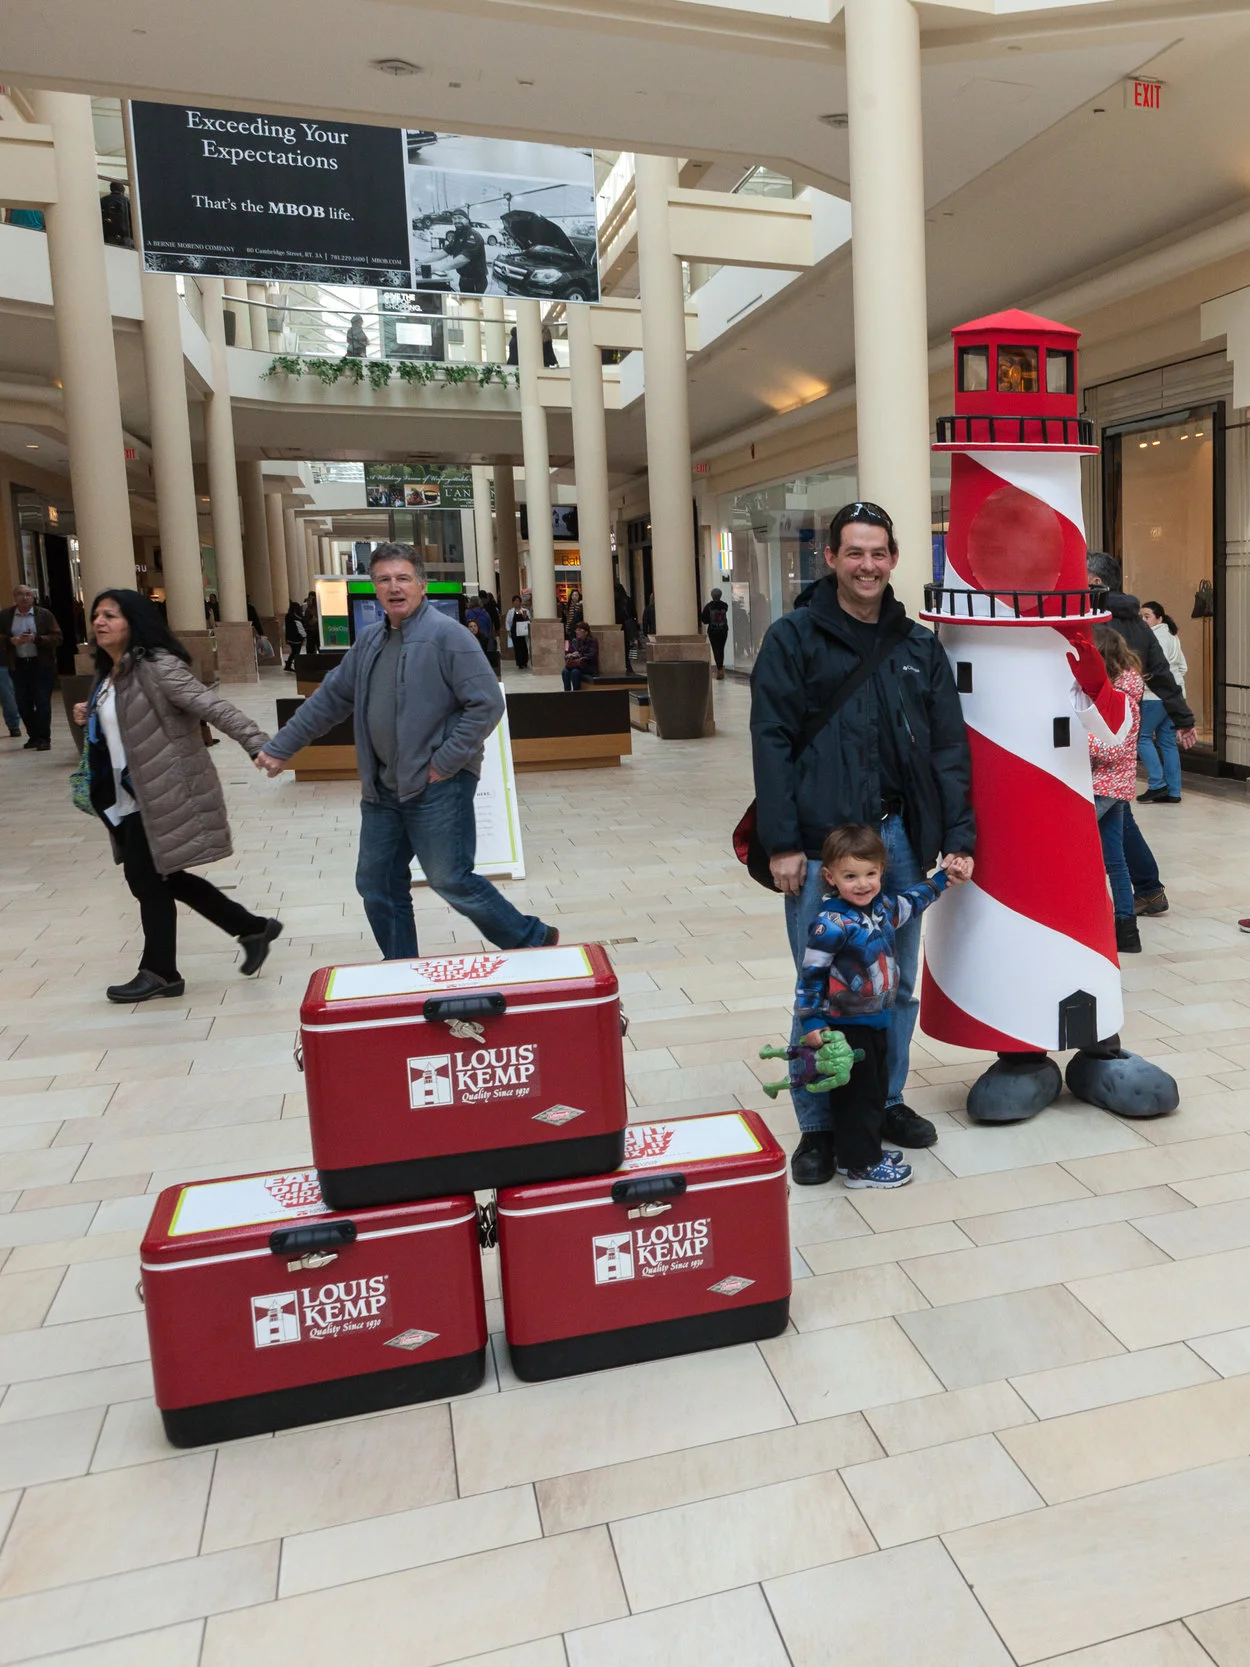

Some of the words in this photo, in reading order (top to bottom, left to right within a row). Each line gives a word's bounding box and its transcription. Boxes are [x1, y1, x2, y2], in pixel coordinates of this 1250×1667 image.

[1134, 82, 1161, 109] EXIT
[185, 110, 296, 145] Exceeding
[300, 123, 349, 145] Your
[201, 139, 338, 170] Expectations
[191, 194, 237, 211] That's
[241, 200, 264, 213] the
[268, 201, 325, 218] MBOB
[329, 207, 355, 221] life.
[153, 240, 176, 248] BERNIE
[176, 242, 204, 250] MORENO
[204, 244, 235, 252] COMPANY
[255, 248, 285, 257] Cambridge
[456, 1064, 535, 1092] KEMP
[462, 1087, 492, 1104] Quality
[493, 1088, 514, 1098] Since
[515, 1087, 530, 1097] 1930
[271, 1181, 320, 1196] DIP
[282, 1195, 317, 1206] MIX
[637, 1238, 709, 1266] KEMP
[641, 1261, 669, 1277] Quality
[670, 1261, 688, 1271] Since
[303, 1296, 387, 1327] KEMP
[309, 1323, 341, 1340] Quality
[342, 1320, 364, 1332] Since
[366, 1319, 382, 1329] 1930
